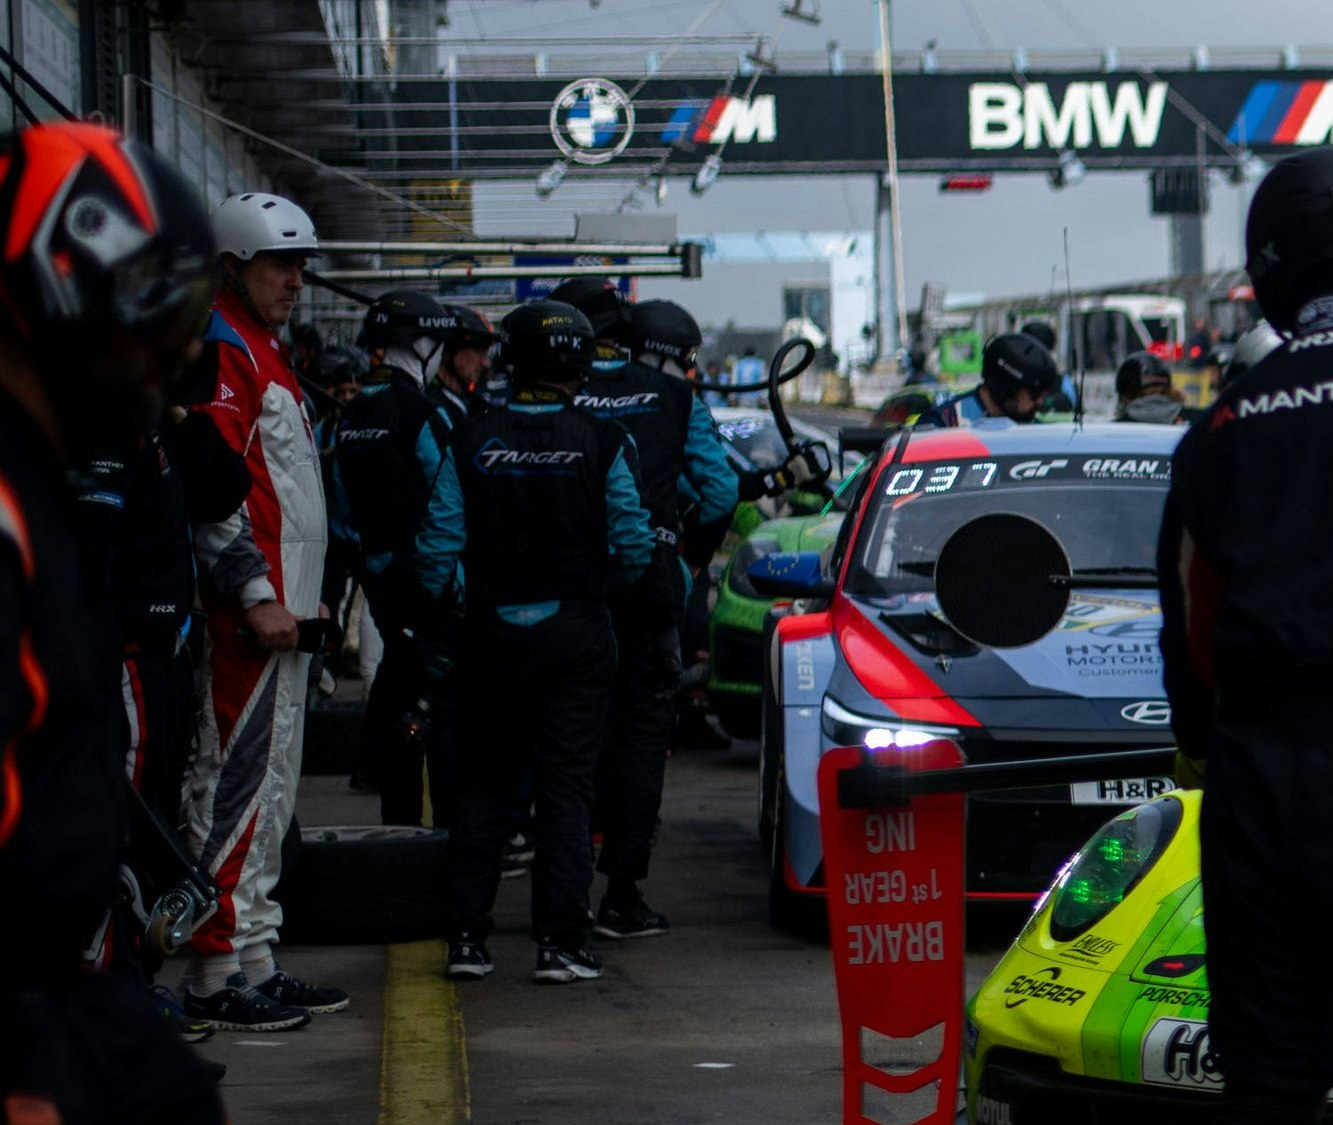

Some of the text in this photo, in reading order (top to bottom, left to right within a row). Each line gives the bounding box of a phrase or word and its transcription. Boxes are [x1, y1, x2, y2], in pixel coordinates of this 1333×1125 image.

[967, 81, 1169, 150] BMW
[419, 316, 457, 329] uvex
[572, 392, 659, 408] TARGET
[480, 449, 584, 469] TARGET
[1082, 459, 1160, 474] GRAN
[886, 461, 997, 496] 037
[1099, 778, 1168, 801] H&R
[864, 811, 916, 854] ING
[844, 868, 942, 905] 1st GEAR
[847, 921, 944, 964] BRAKE
[1003, 974, 1087, 1007] SCHERER
[1137, 986, 1212, 1009] PORSCH
[1164, 1023, 1225, 1084] H&
